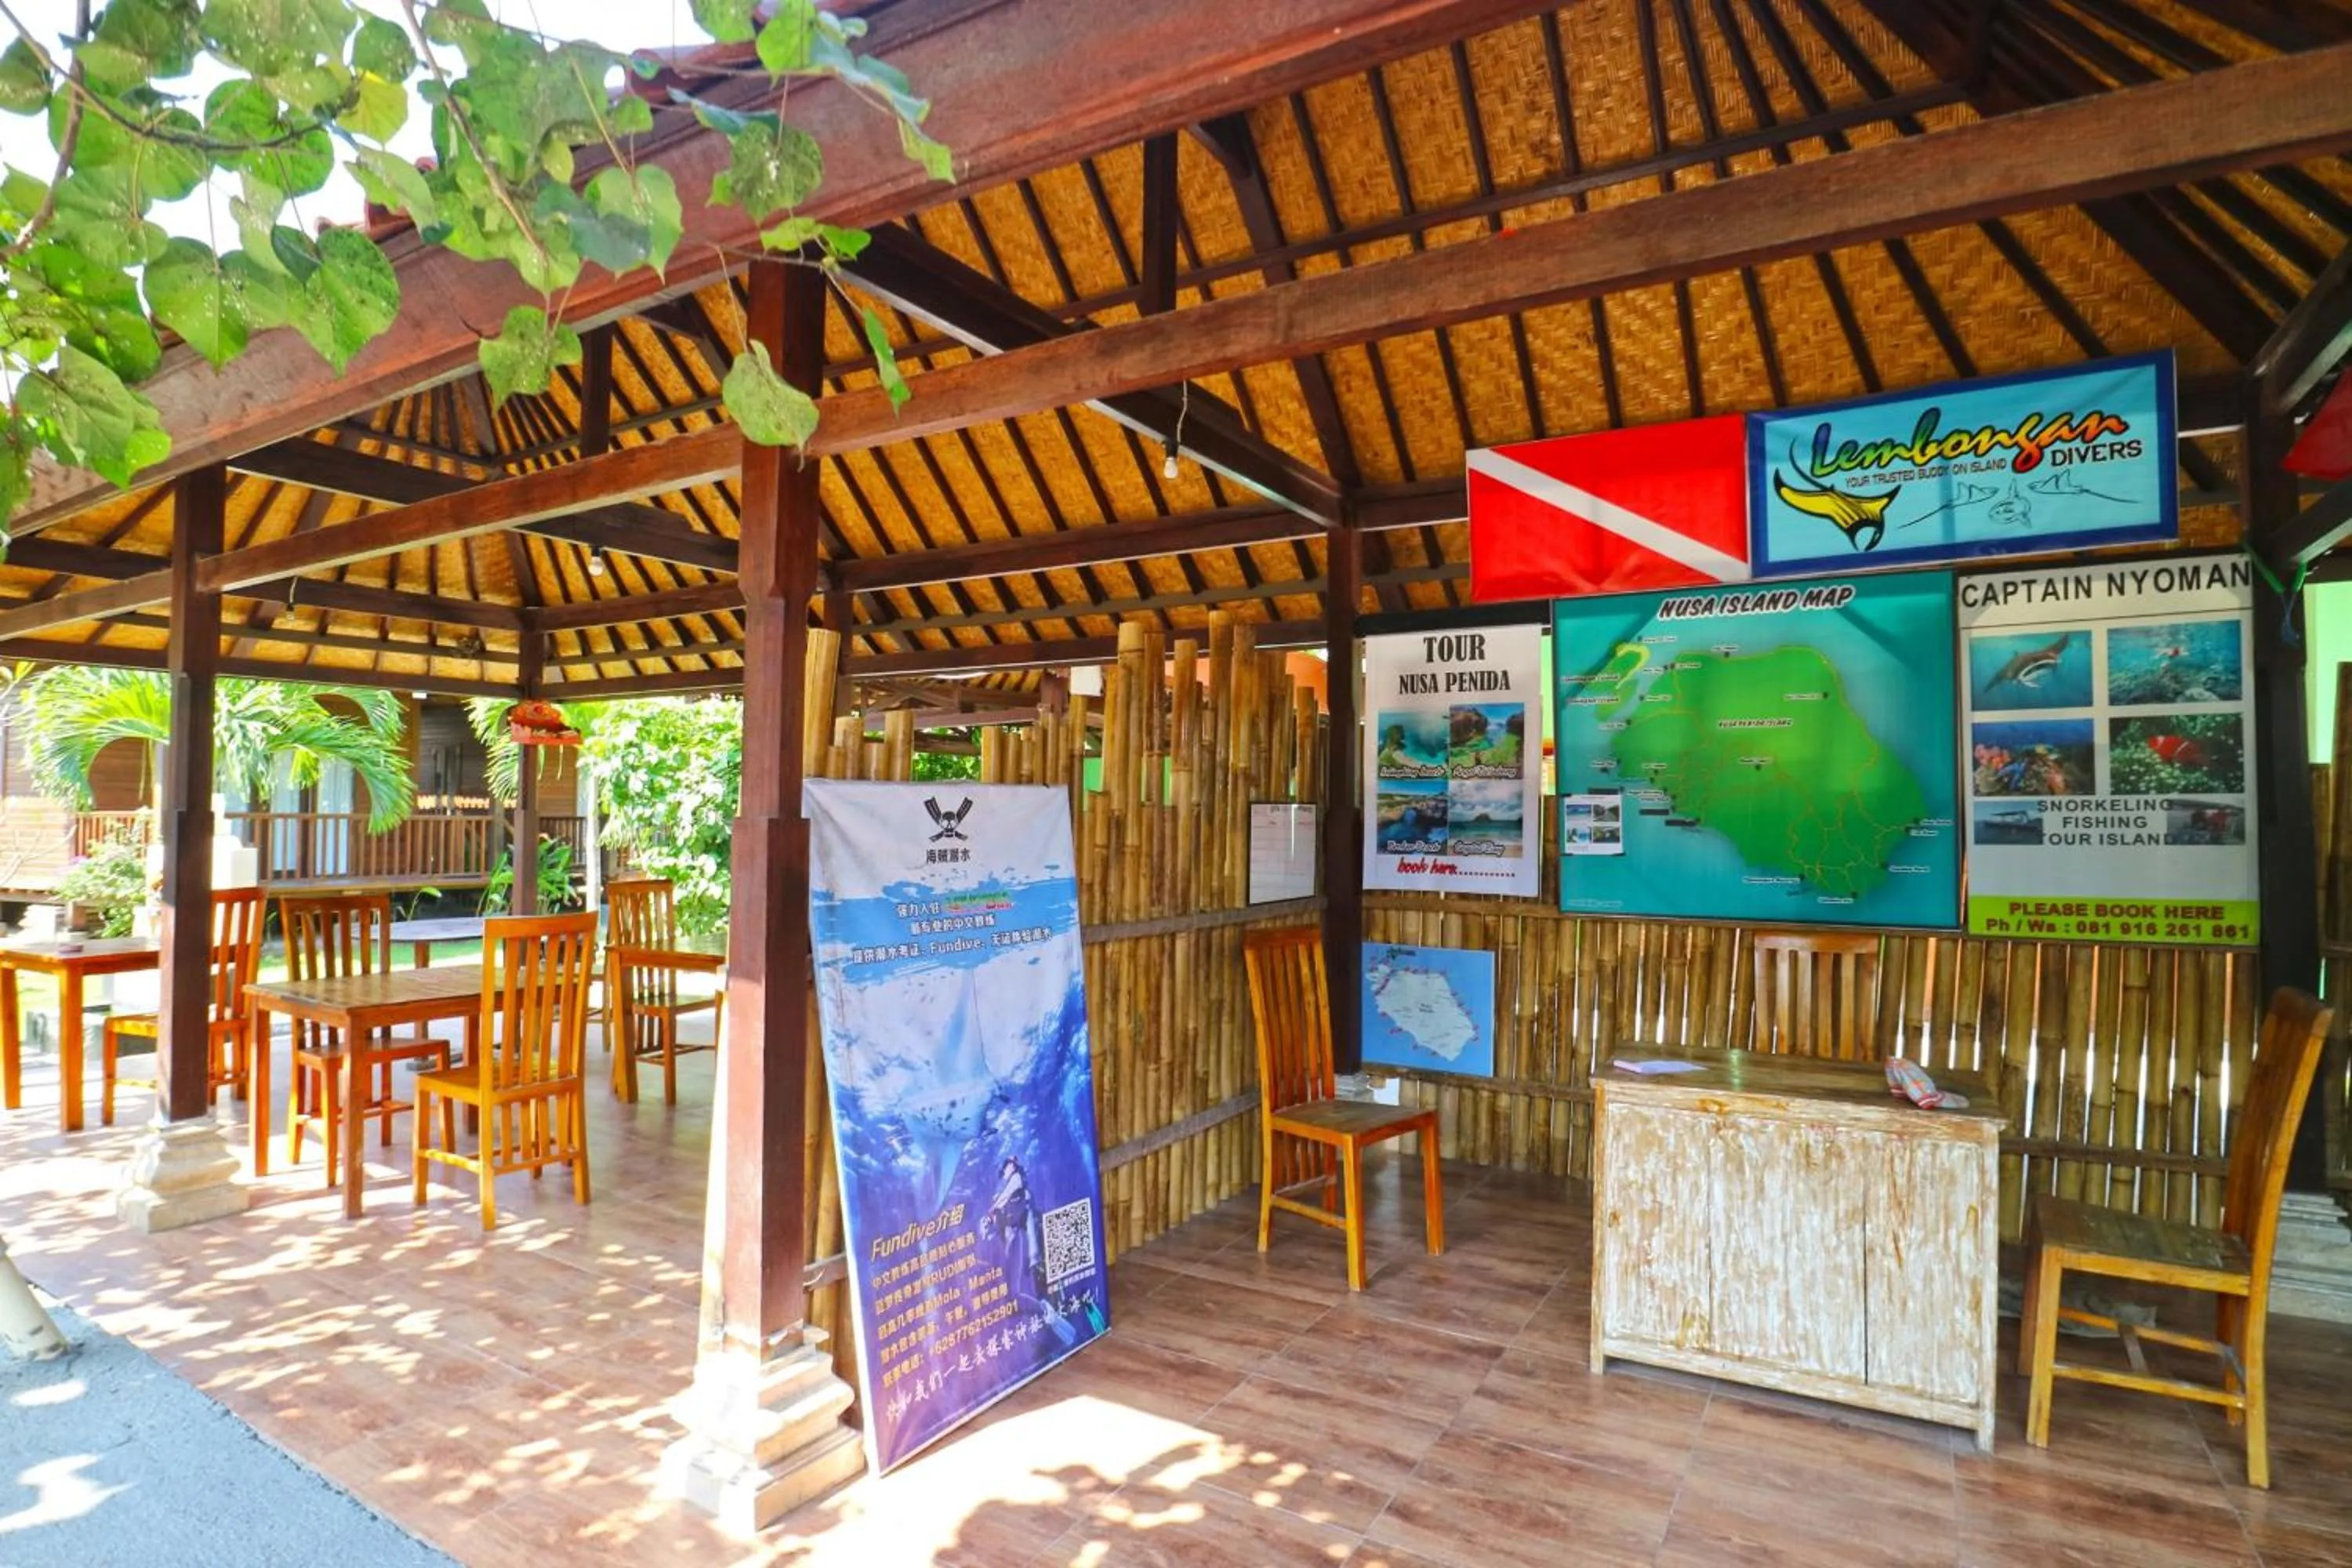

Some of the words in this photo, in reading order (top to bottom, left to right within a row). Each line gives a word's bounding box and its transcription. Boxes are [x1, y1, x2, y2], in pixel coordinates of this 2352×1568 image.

[1811, 407, 2129, 477] Lembongan
[2050, 440, 2143, 467] DIVERS
[1846, 475, 1871, 488] YOUR
[1873, 470, 1915, 485] TRUSTED
[1918, 466, 1950, 480] BUDDY
[1952, 463, 1969, 477] ON
[1970, 458, 2007, 474] ISLAND
[1962, 574, 2092, 609] CAPTAIN
[2107, 561, 2252, 597] NYOMAN
[1658, 597, 1717, 621] NUSA
[1719, 590, 1798, 615] ISLAND
[1802, 584, 1855, 609] MAP
[1423, 633, 1486, 663] TOUR
[1399, 673, 1439, 695] NUSA
[1446, 670, 1511, 692] PENIDA
[2037, 799, 2173, 813] SNORKELING
[2062, 815, 2148, 829] FISHING
[1397, 856, 1428, 874] book
[2009, 902, 2089, 917] PLEASE
[2095, 903, 2157, 919] BOOK
[2164, 906, 2225, 920] HERE
[1986, 919, 2011, 932] Ph
[2027, 920, 2057, 934] Wa
